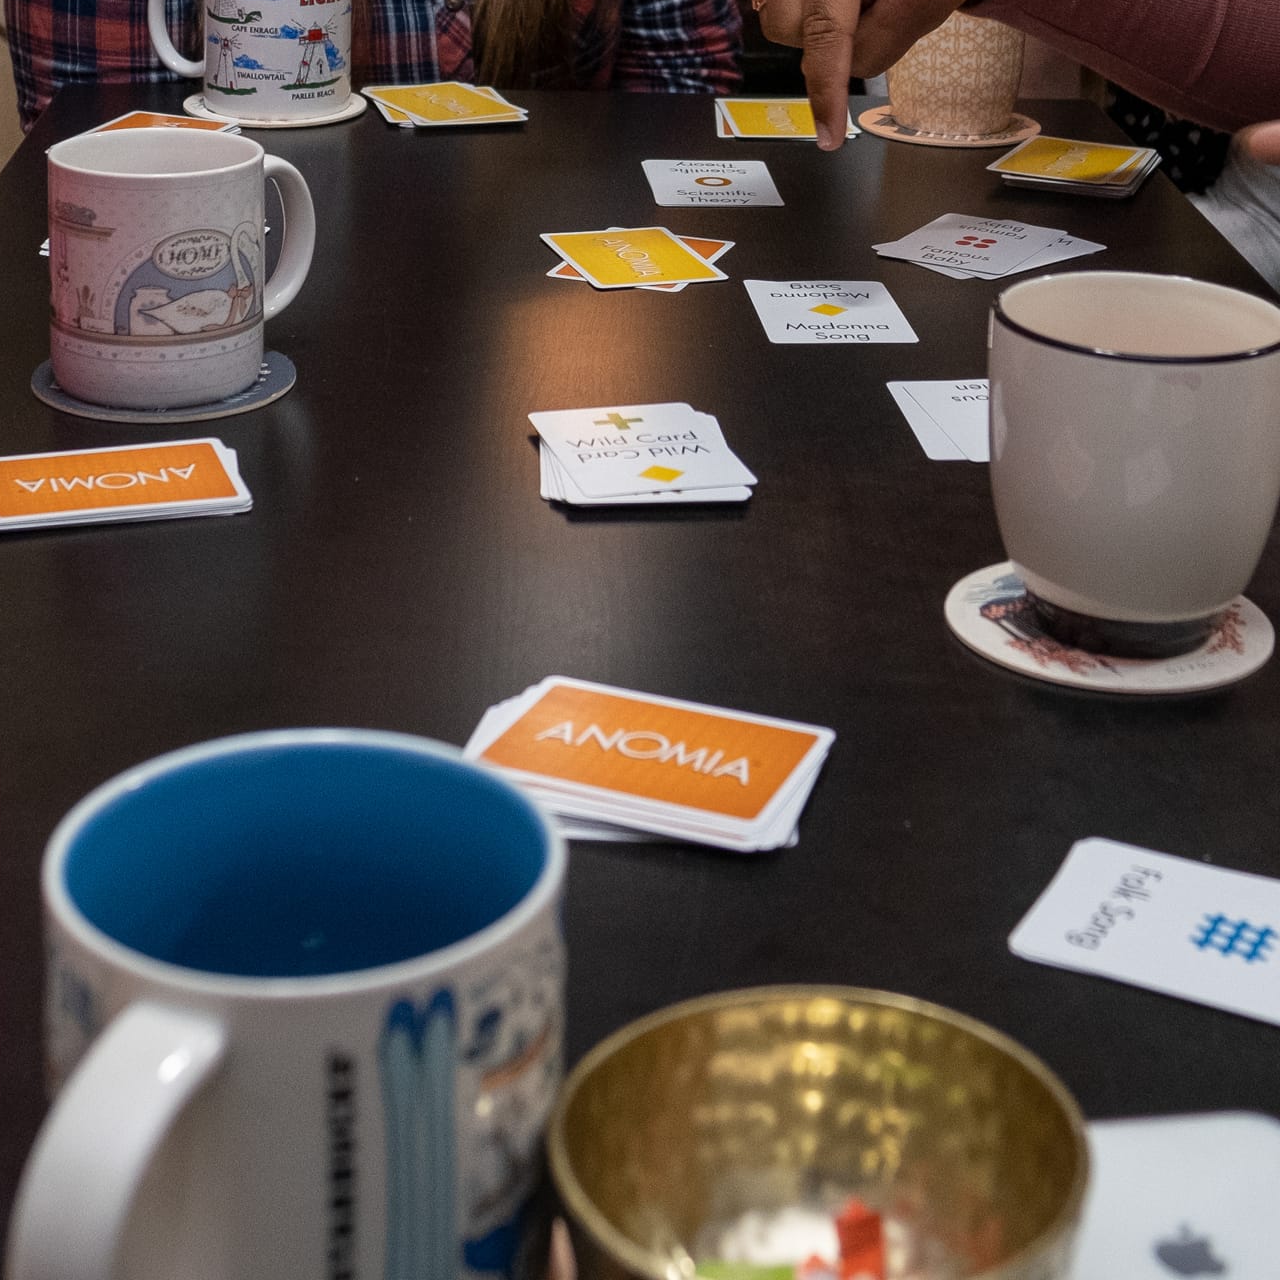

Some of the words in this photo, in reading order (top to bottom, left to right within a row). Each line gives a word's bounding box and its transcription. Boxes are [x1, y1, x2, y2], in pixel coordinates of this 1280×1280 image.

[231, 24, 247, 33] CAPE
[249, 27, 279, 35] ENRAGE
[236, 71, 286, 81] SWALLOWTAIL
[291, 93, 315, 101] PARLEE
[676, 189, 757, 197] Scientific
[686, 196, 752, 205] Theory
[959, 224, 1029, 240] Famous
[978, 220, 1025, 233] Baby
[919, 244, 992, 261] Famous
[921, 252, 971, 266] Baby
[789, 283, 842, 291] Song
[786, 322, 890, 330] Madonna
[815, 331, 871, 341] Song
[566, 435, 628, 450] Wild
[636, 430, 698, 444] Card
[576, 448, 640, 464] Card
[648, 444, 712, 459] Wild
[14, 463, 196, 493] ANOMIA
[534, 720, 751, 787] ANOMIA
